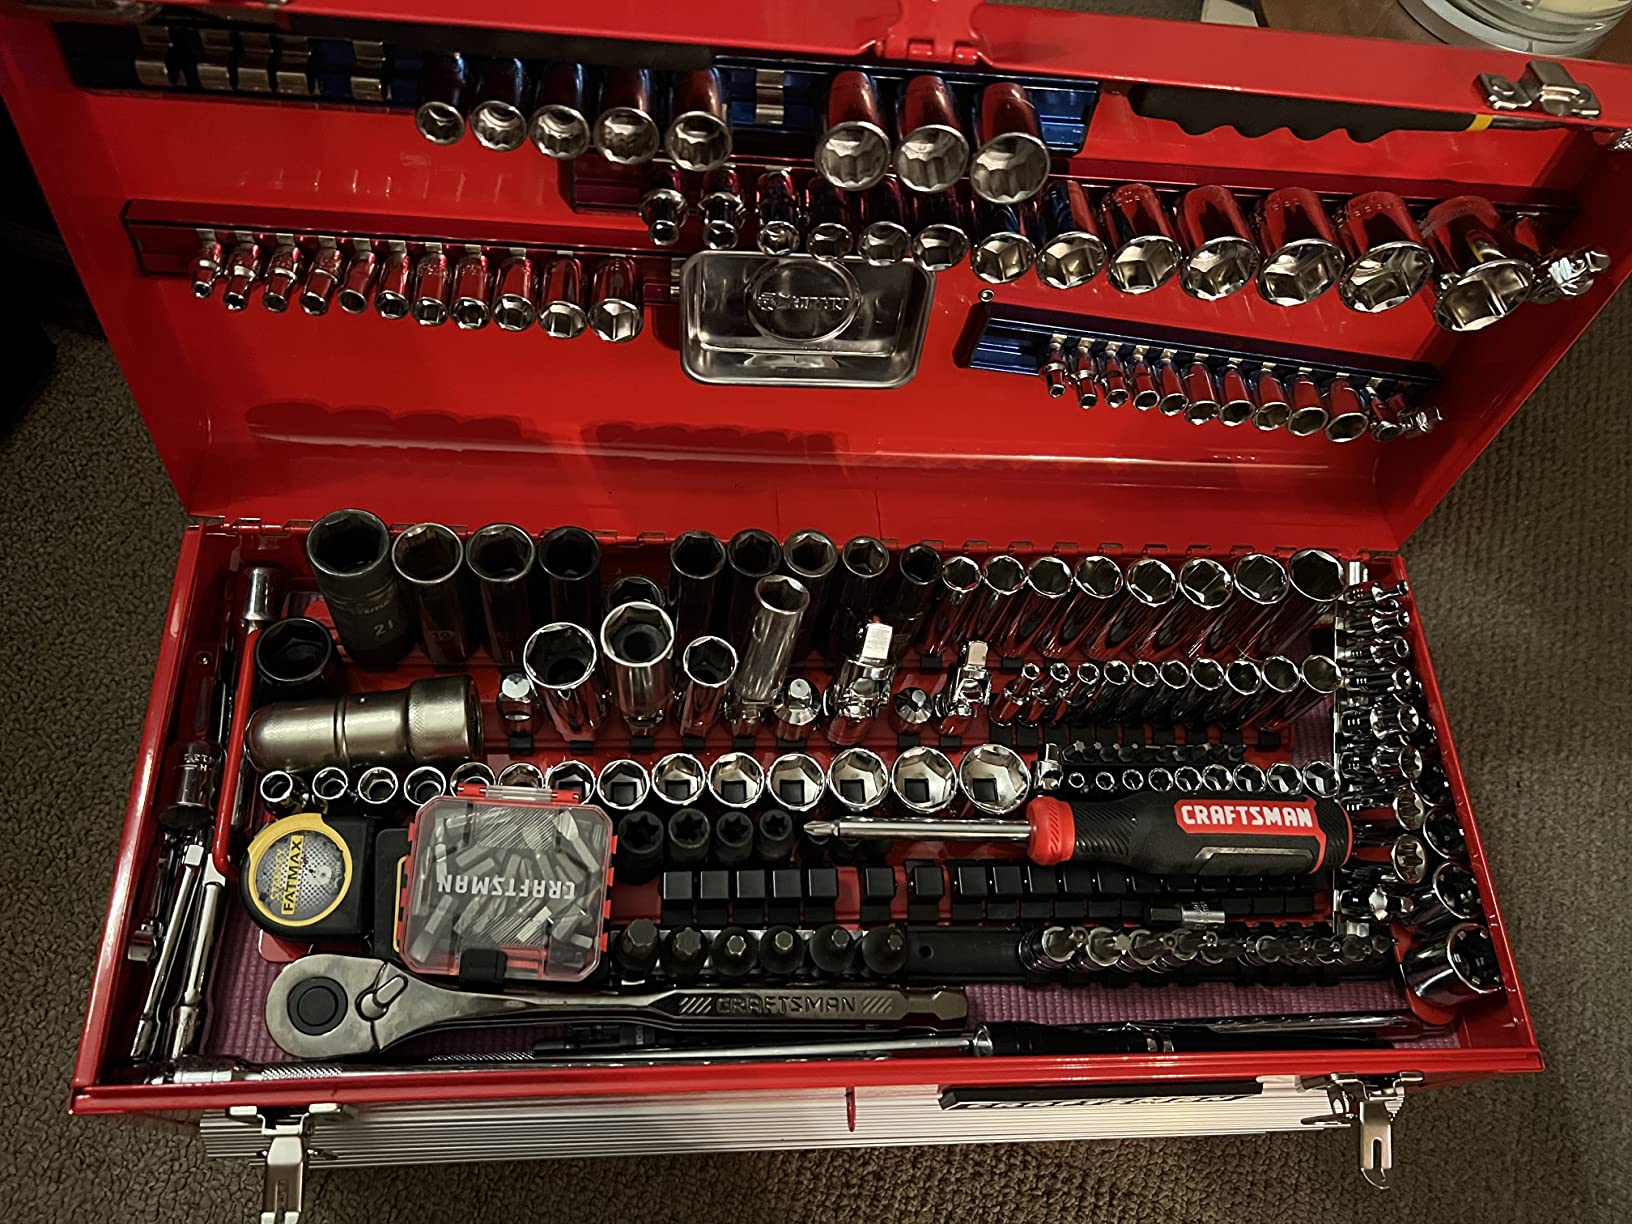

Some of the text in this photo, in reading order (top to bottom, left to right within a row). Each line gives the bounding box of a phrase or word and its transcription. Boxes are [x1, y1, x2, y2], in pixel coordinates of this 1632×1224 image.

[374, 619, 394, 636] 21
[1180, 804, 1314, 828] CRAFTSMAN
[283, 840, 302, 912] FATMAX
[438, 874, 576, 900] CRAFTSMAN
[715, 995, 856, 1015] CRAFTSMAN
